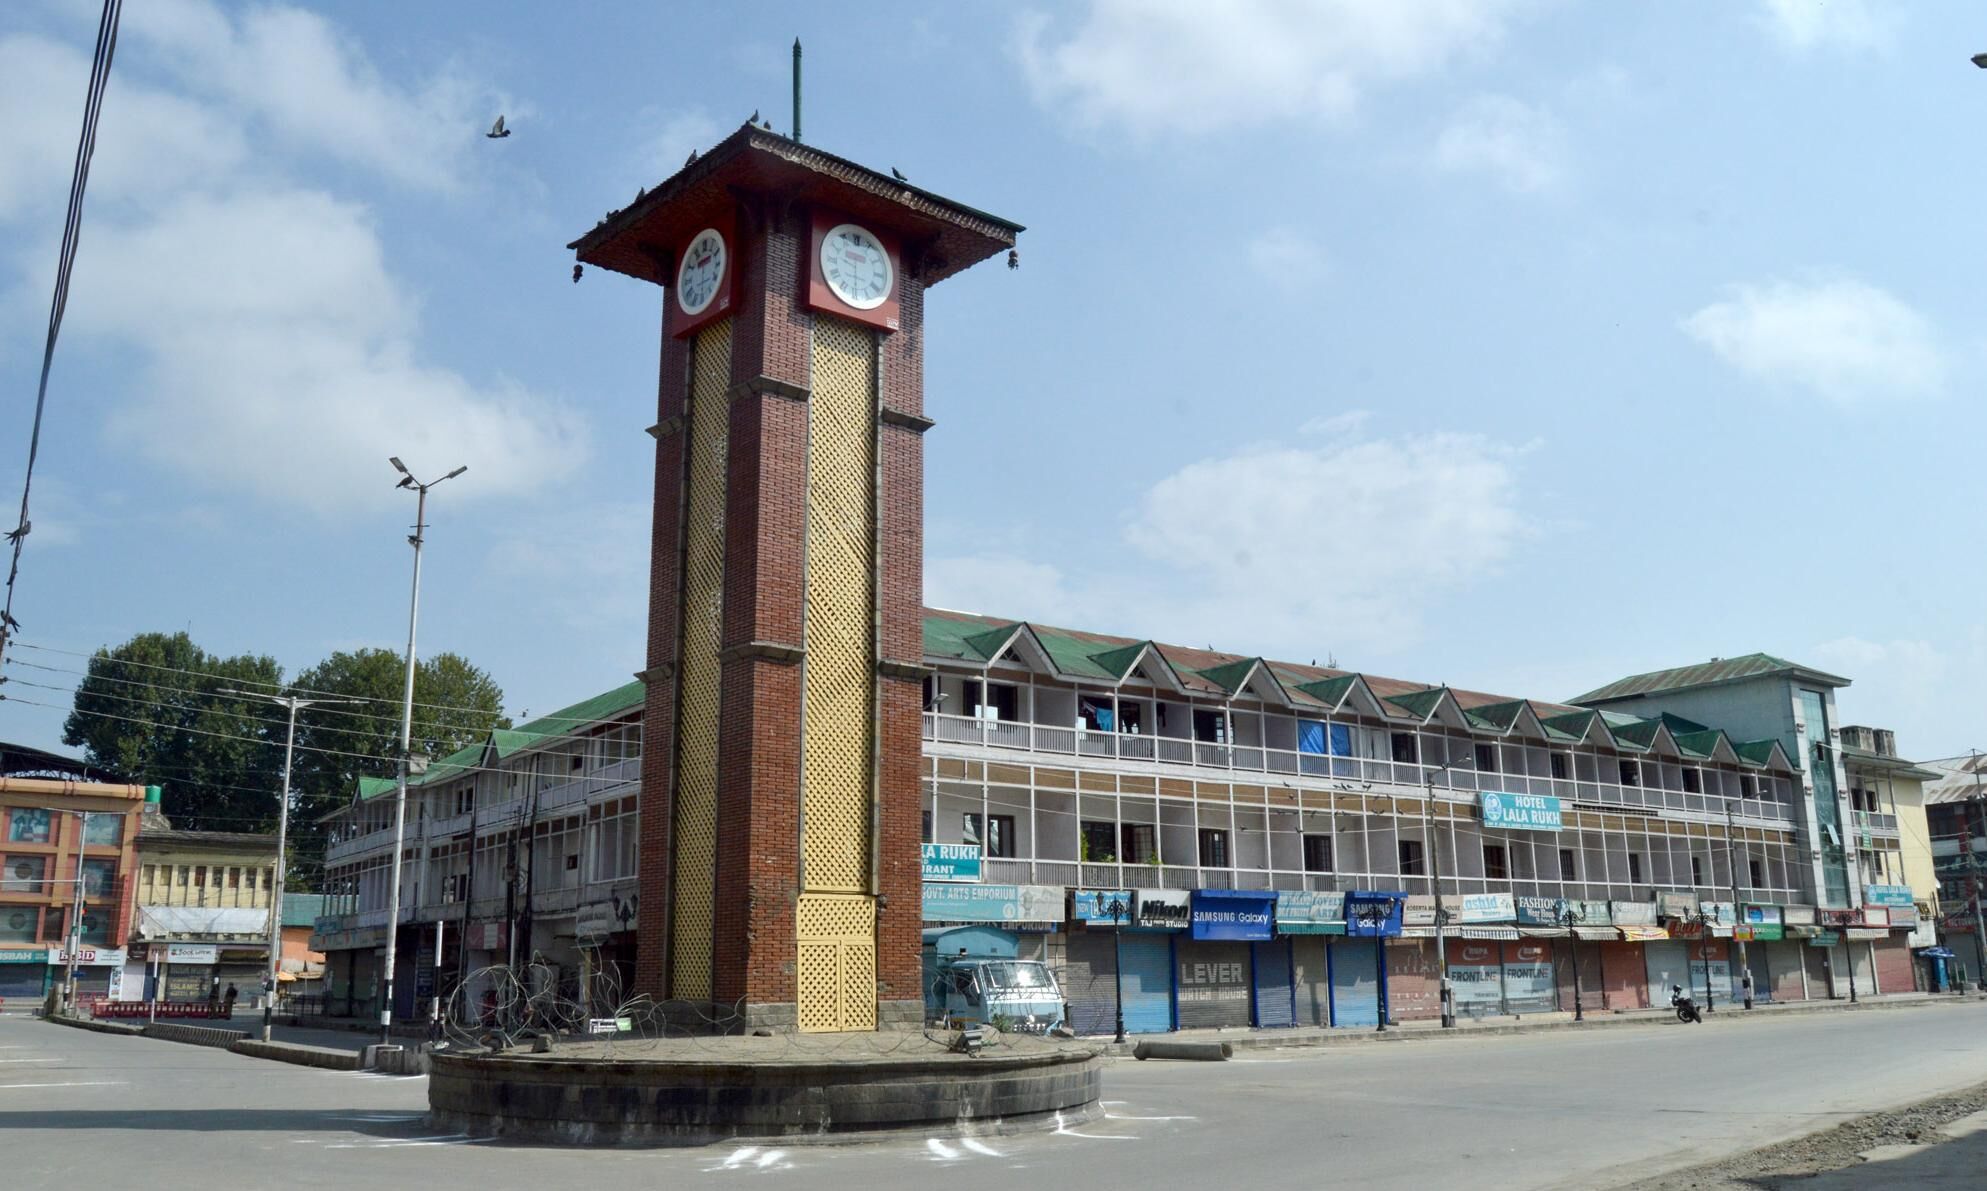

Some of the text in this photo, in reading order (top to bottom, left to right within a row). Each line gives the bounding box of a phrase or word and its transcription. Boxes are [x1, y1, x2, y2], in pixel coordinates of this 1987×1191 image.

[1515, 796, 1546, 809] HOTEL
[1503, 808, 1560, 825] LALA RUKH
[940, 846, 978, 860] RUKH
[922, 865, 955, 874] RANT
[947, 888, 969, 900] ARTS
[972, 888, 1016, 900] EMPORIUM
[1141, 900, 1188, 918] Nikon
[1519, 897, 1557, 909] FASHION
[1165, 920, 1188, 928] STUDIO
[1194, 912, 1268, 925] SAMSUNG Galaxy
[1182, 963, 1243, 984] LEVER
[1451, 971, 1497, 982] FRONTLINE
[1507, 968, 1549, 979] FRONTLINE
